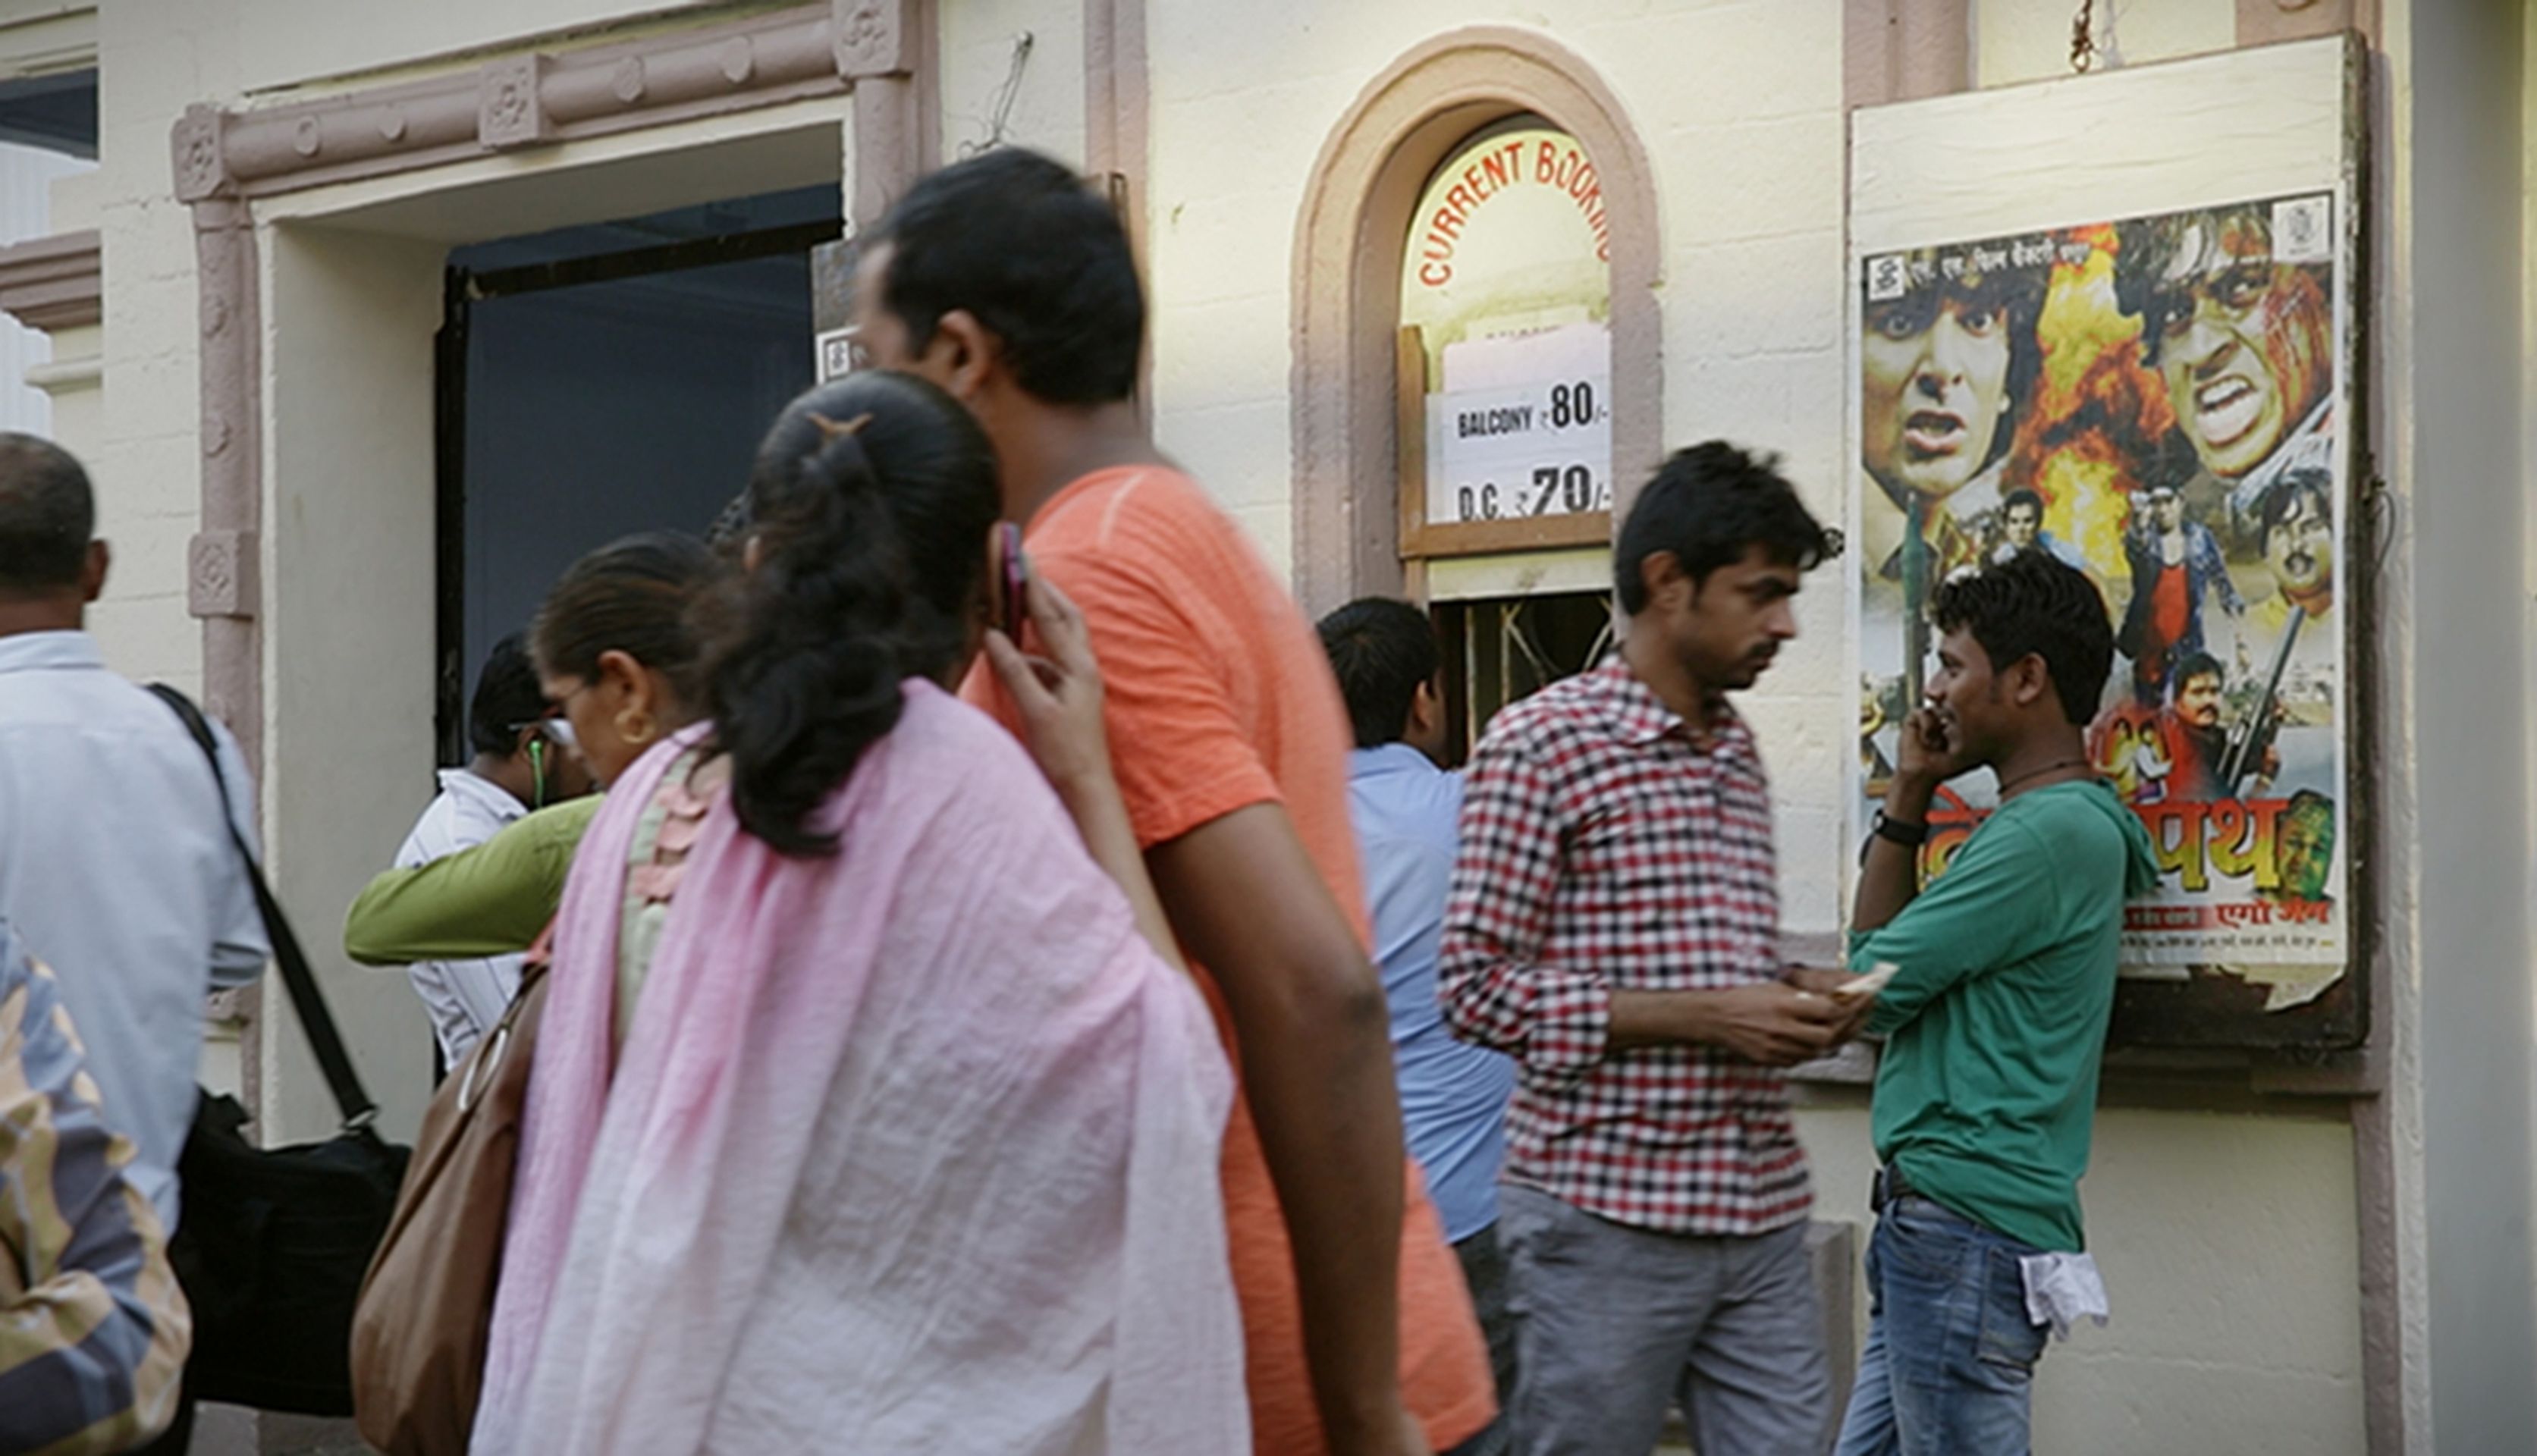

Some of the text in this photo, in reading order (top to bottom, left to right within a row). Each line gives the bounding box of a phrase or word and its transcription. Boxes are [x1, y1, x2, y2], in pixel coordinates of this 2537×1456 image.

[1418, 141, 1524, 287] CURRENT
[1458, 406, 1533, 438] BALCONY
[1458, 483, 1506, 521] D.C.
